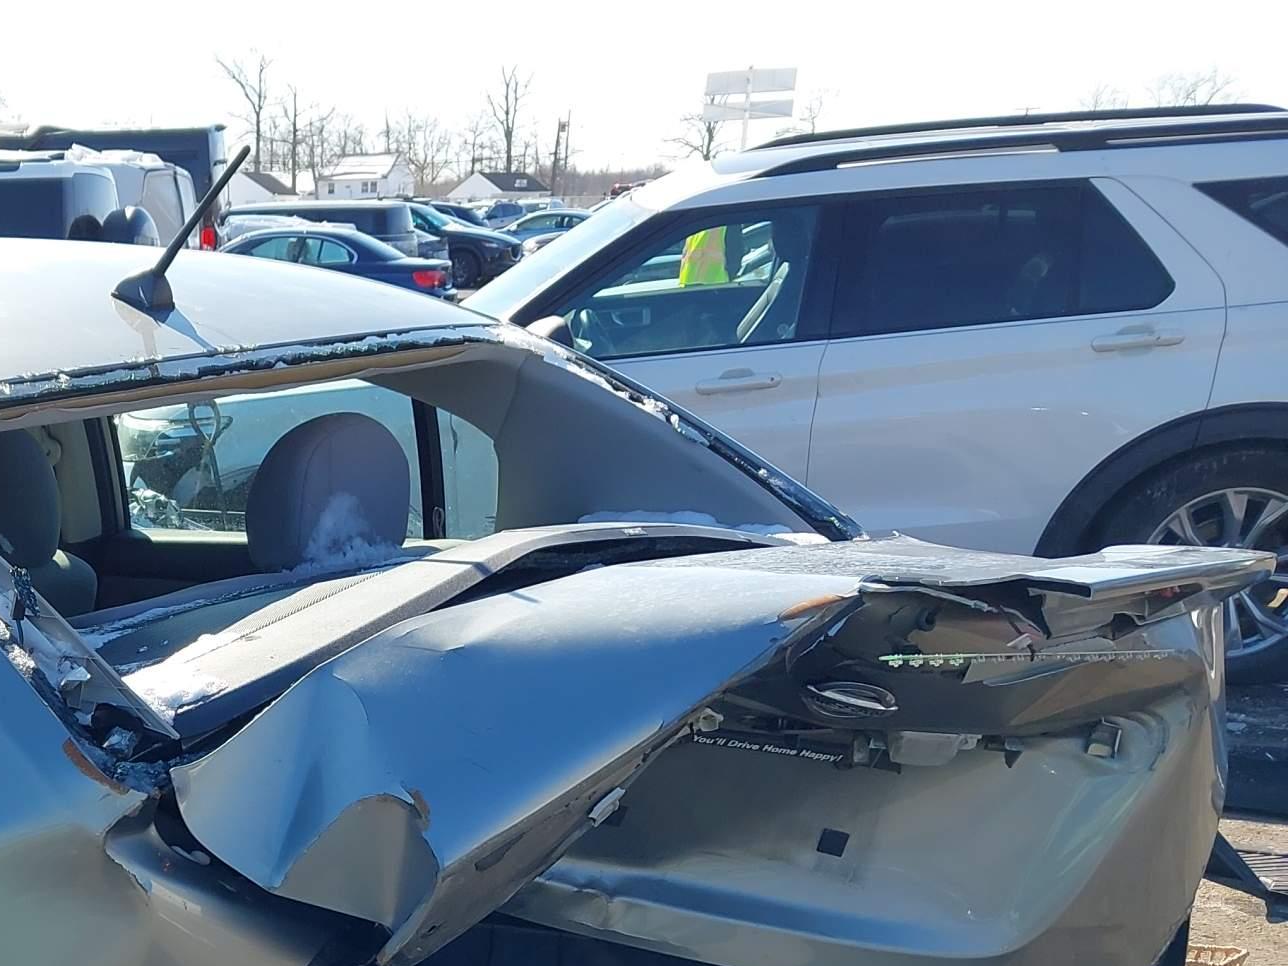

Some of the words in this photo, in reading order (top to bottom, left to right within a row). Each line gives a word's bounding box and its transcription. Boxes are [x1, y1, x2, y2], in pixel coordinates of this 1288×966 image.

[692, 734, 726, 746] You'll
[727, 739, 760, 750] Drive
[762, 744, 798, 756] Home
[800, 749, 844, 762] Happy!
